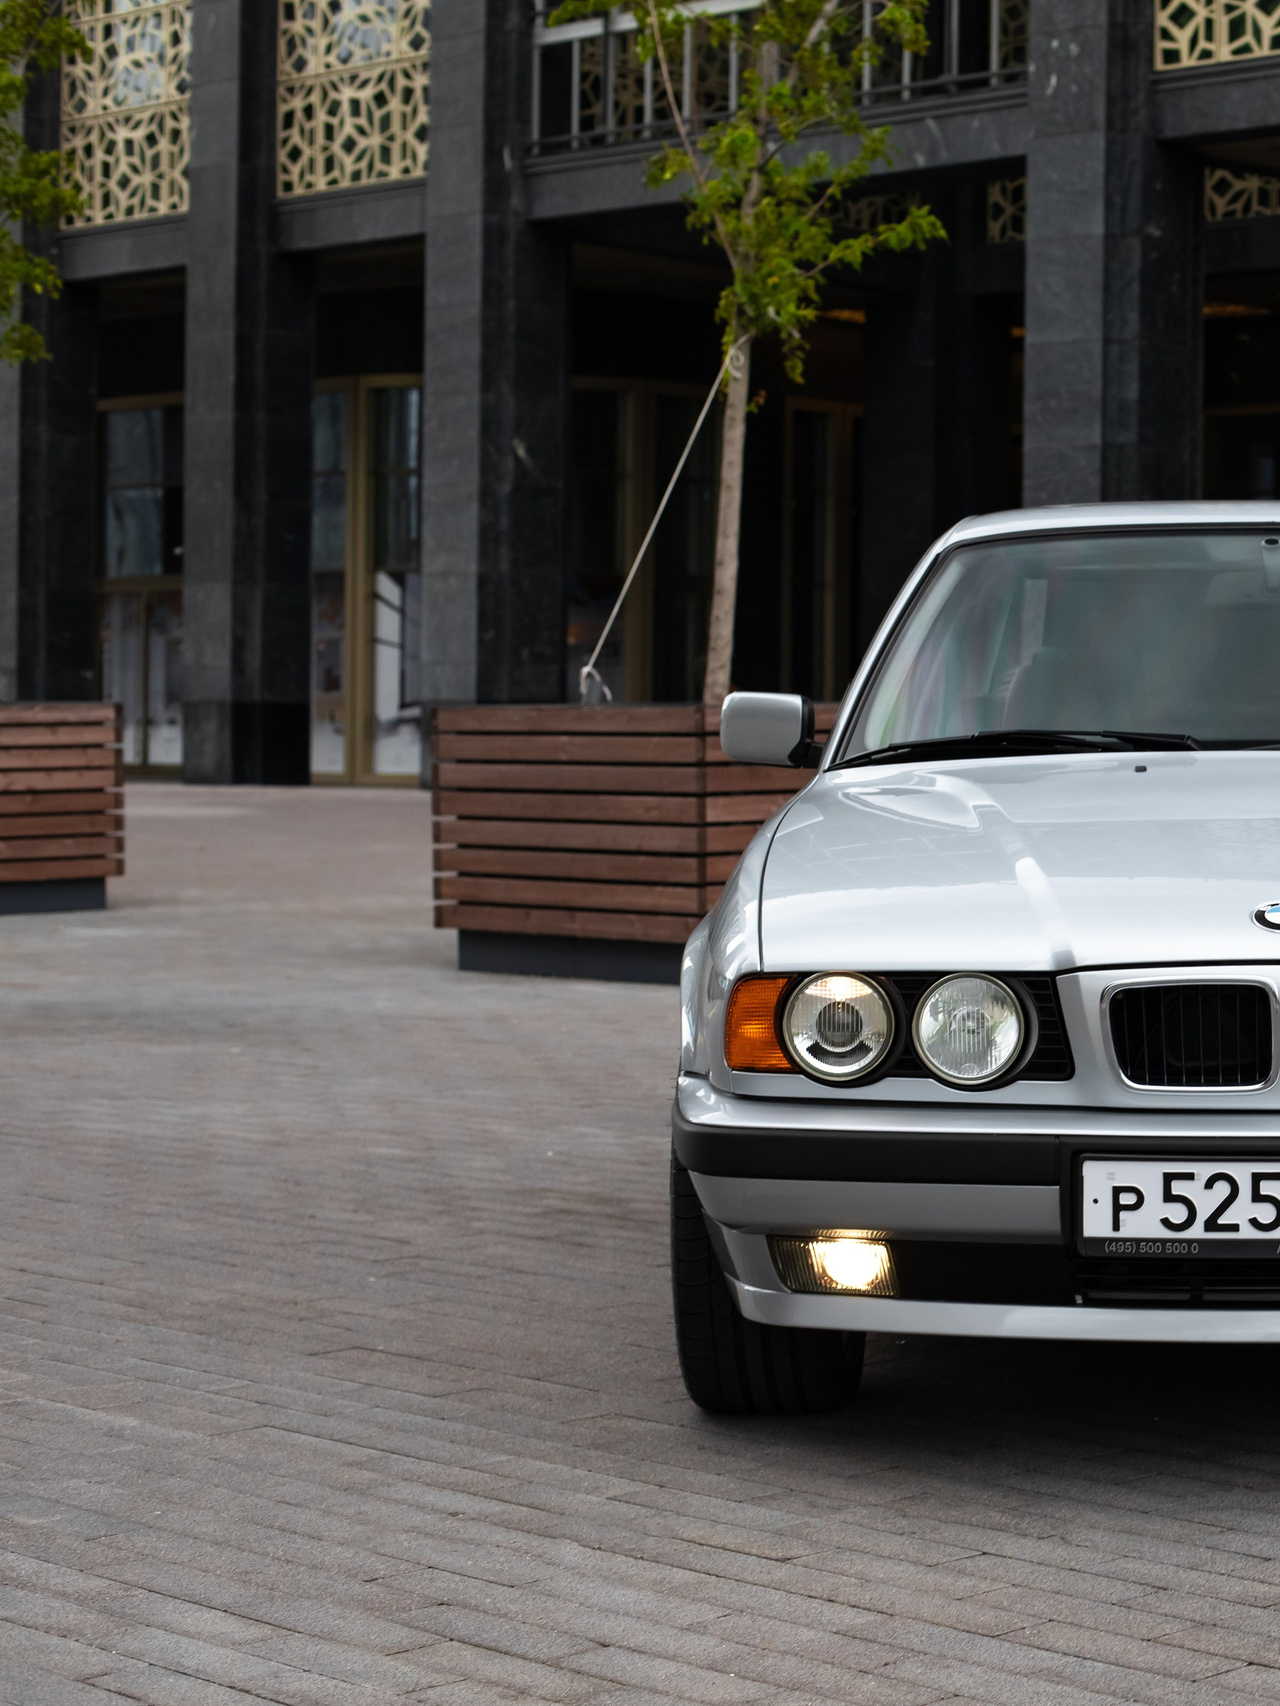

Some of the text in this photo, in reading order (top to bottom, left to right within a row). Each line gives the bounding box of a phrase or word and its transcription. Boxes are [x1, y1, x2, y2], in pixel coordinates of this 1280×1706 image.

[1105, 1241, 1199, 1254] (495) 500 500 0
